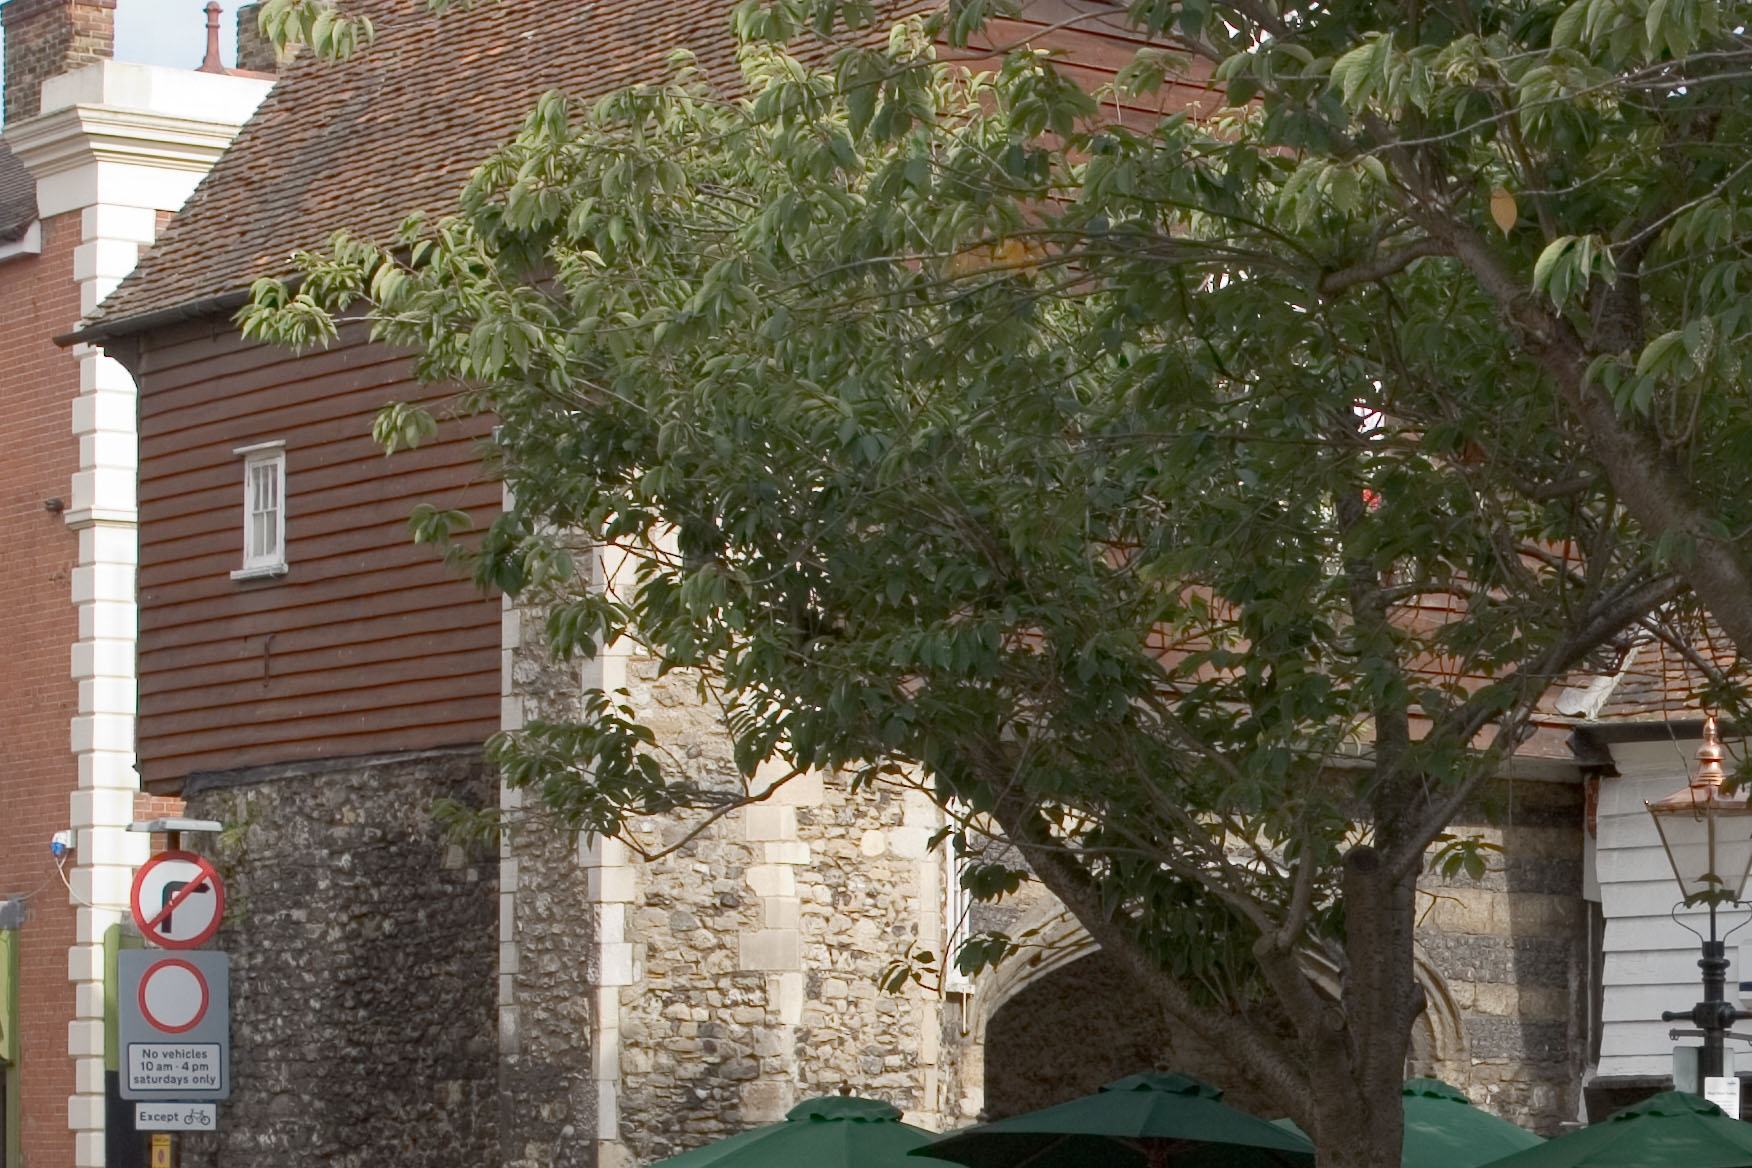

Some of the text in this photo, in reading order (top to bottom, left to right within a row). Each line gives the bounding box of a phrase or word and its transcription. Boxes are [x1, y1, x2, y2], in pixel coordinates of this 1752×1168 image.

[142, 1049, 208, 1059] No vehicles
[141, 1061, 154, 1072] 10
[156, 1063, 173, 1072] am
[182, 1061, 189, 1072] 4
[192, 1063, 209, 1074] pm
[134, 1074, 217, 1086] saturdays only
[140, 1111, 180, 1123] Except
